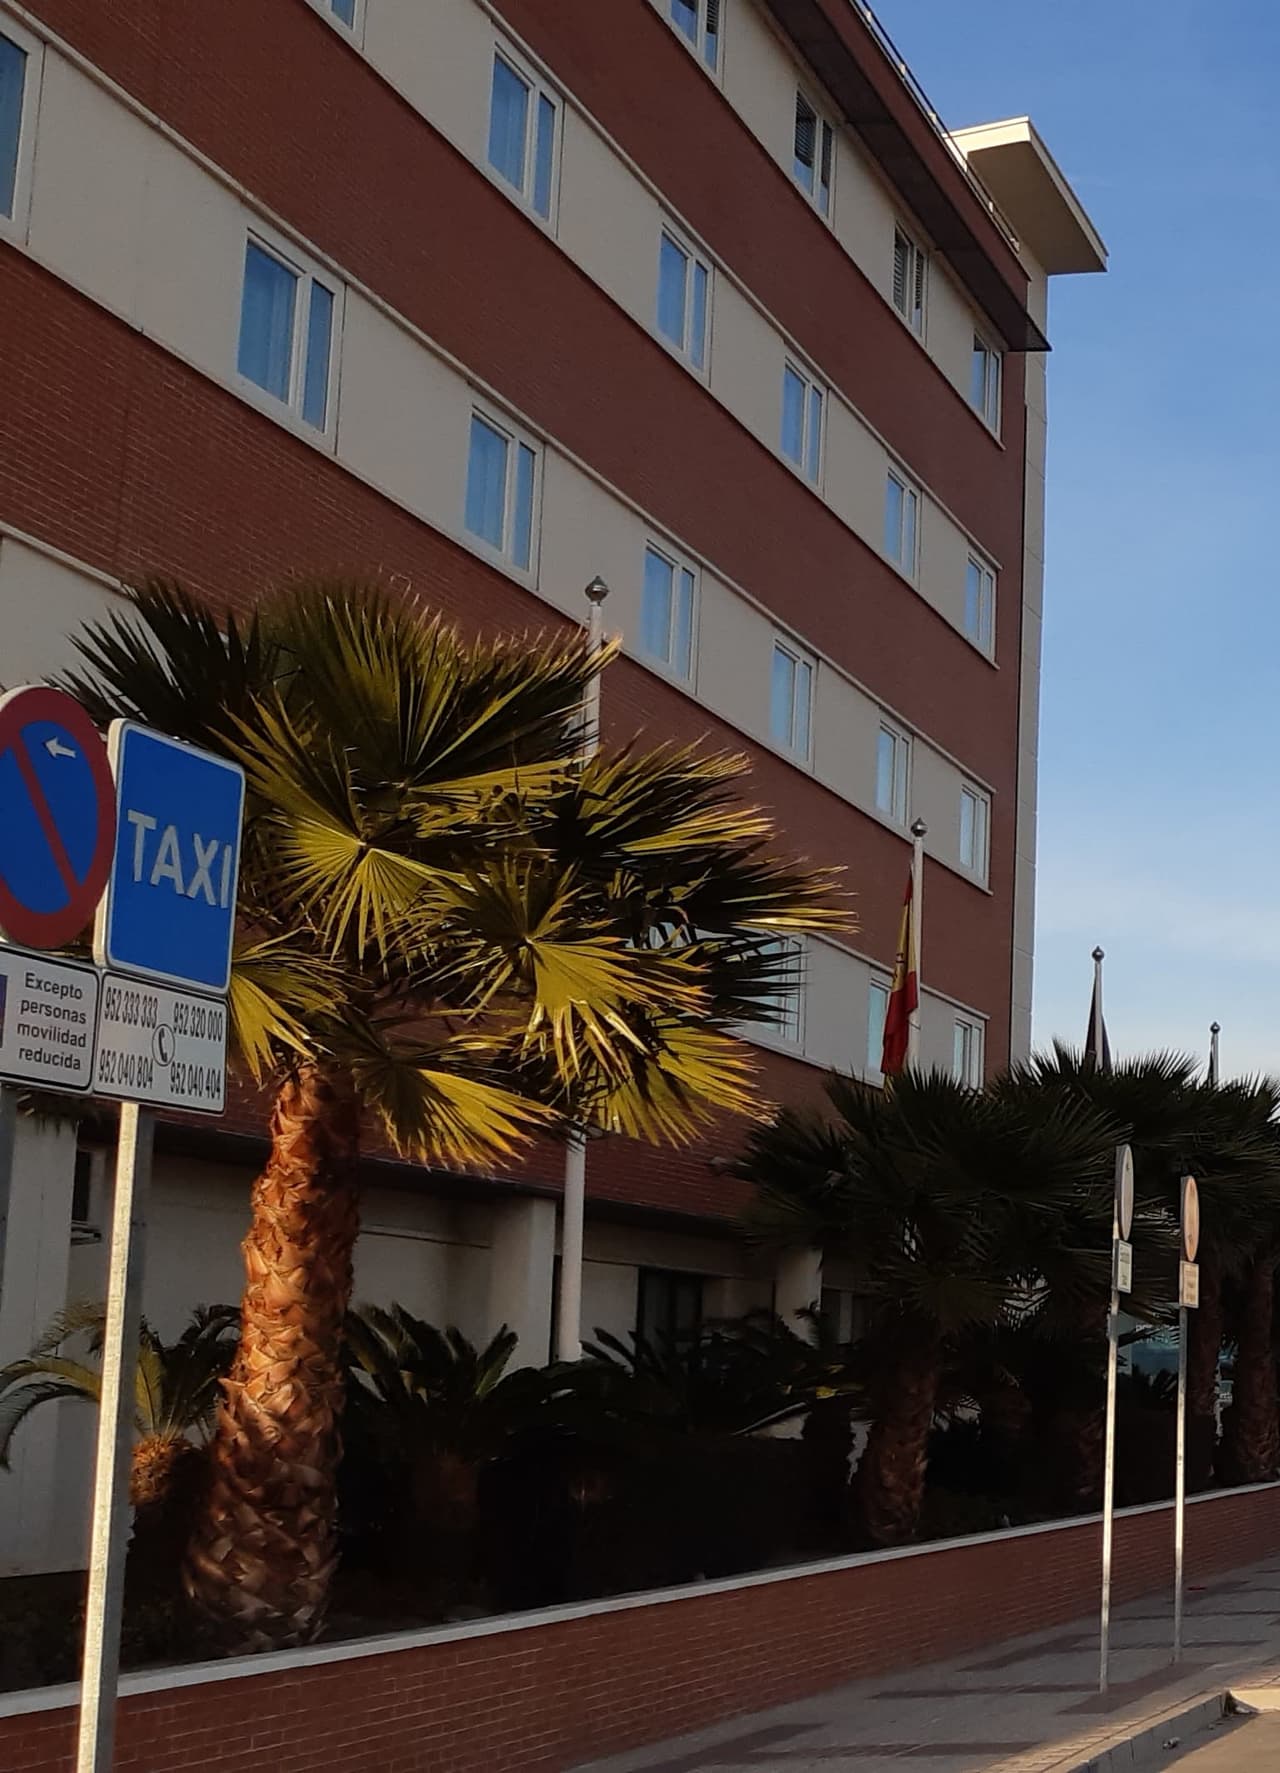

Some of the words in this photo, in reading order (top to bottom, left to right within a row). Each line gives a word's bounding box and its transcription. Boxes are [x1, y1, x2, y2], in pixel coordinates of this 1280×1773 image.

[127, 808, 233, 909] TAXI
[25, 971, 83, 1000] Excepto
[20, 999, 87, 1024] personas
[104, 986, 122, 1021] 952
[122, 990, 141, 1026] 333
[141, 994, 158, 1030] 333
[173, 1001, 189, 1036] 952
[190, 1005, 206, 1039] 320
[207, 1009, 223, 1042] 000
[17, 1022, 87, 1048] movilidad
[19, 1047, 81, 1070] reducida
[99, 1049, 116, 1084] 952
[117, 1052, 135, 1087] 040
[136, 1055, 154, 1090] 804
[170, 1060, 186, 1095] 952
[187, 1063, 204, 1098] 040
[205, 1067, 221, 1100] 404
